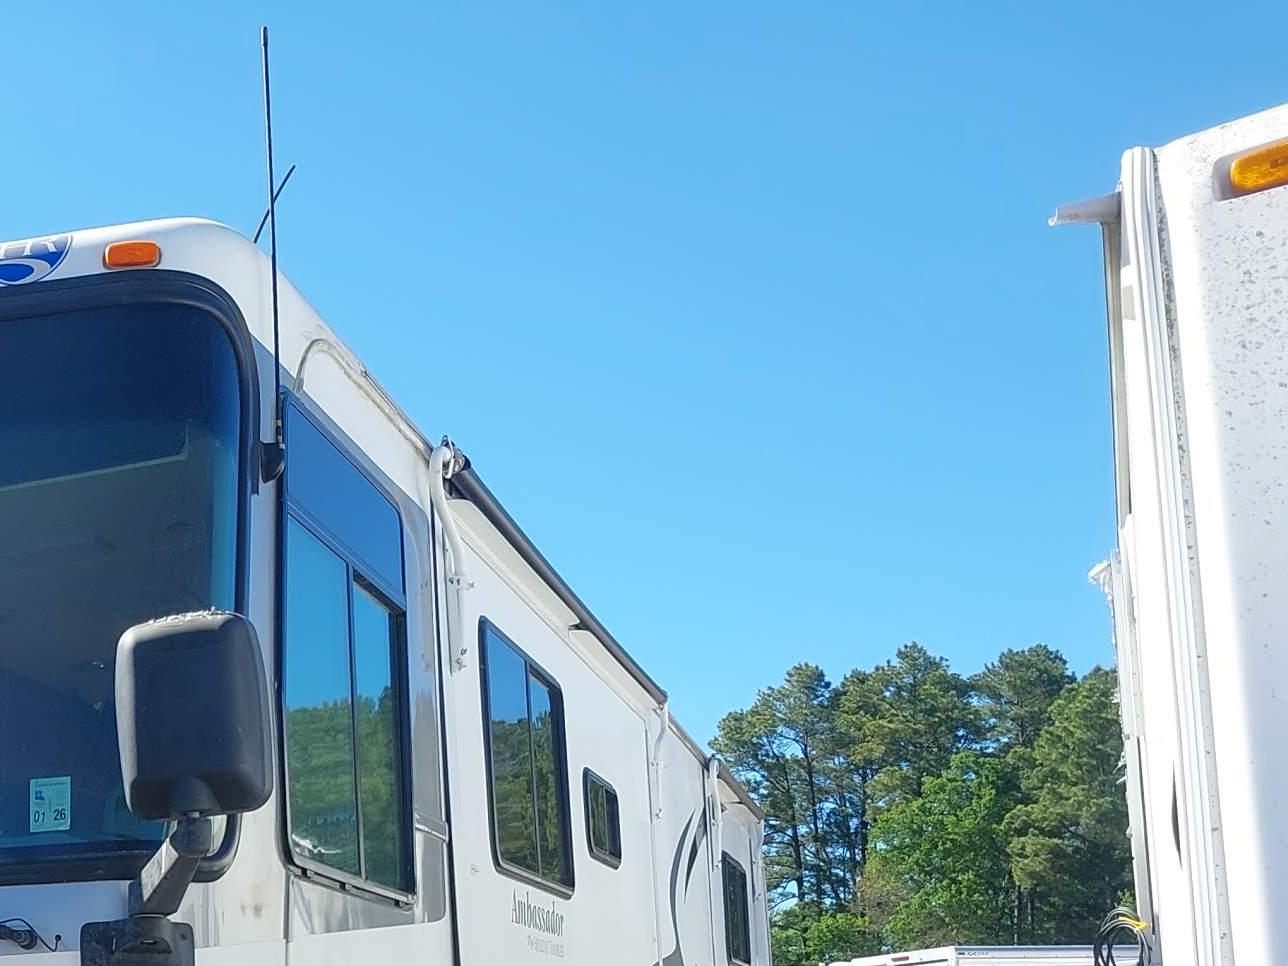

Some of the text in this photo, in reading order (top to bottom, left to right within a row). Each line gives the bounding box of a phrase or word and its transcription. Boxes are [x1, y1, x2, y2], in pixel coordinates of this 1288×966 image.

[33, 808, 66, 823] 01 26
[511, 887, 564, 937] Ambassador
